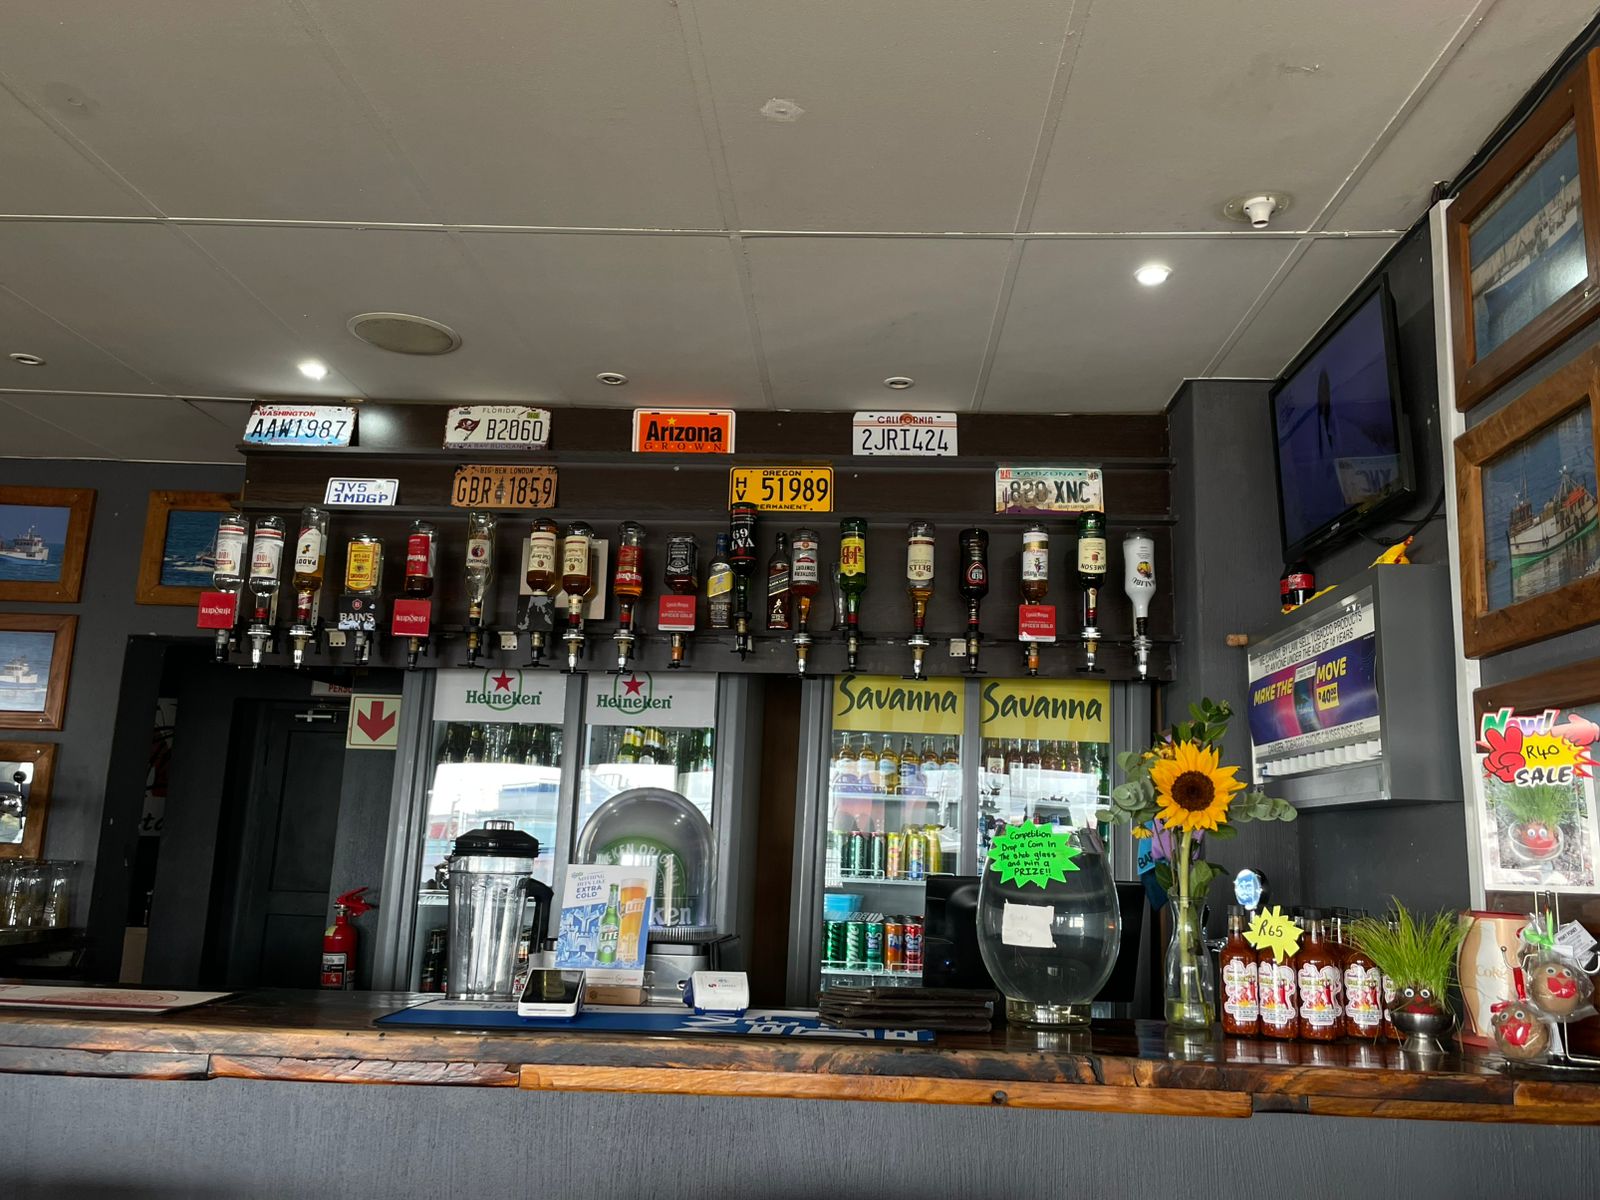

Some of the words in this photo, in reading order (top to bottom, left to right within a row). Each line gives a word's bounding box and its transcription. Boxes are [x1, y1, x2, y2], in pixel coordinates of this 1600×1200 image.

[877, 415, 933, 425] CALIFORNIA
[251, 418, 347, 439] AAW1987
[645, 420, 723, 442] Arizona
[862, 428, 949, 451] 2JRI424
[457, 477, 492, 503] GBR
[509, 477, 553, 504] 1859
[736, 477, 747, 488] H
[761, 477, 829, 503] 51989
[736, 490, 746, 501] V
[1010, 481, 1048, 502] 820
[1054, 481, 1091, 503] XNC
[1253, 684, 1276, 707] MAKE
[1275, 677, 1294, 698] THE
[1316, 656, 1348, 684] MOVE
[465, 690, 542, 705] Heineken
[596, 694, 672, 710] Heineken
[837, 674, 959, 716] Savanna
[981, 682, 1103, 724] Savanna
[1525, 744, 1560, 760] R40
[1515, 766, 1572, 785] SALE
[1010, 830, 1052, 840] Competition
[1001, 843, 1018, 852] Drop
[1008, 860, 1021, 868] and
[1034, 851, 1056, 861] glass
[1014, 867, 1052, 877] PRIZE!!
[576, 885, 603, 893] EXTRA
[599, 931, 619, 941] LITE
[1258, 919, 1283, 938] R65
